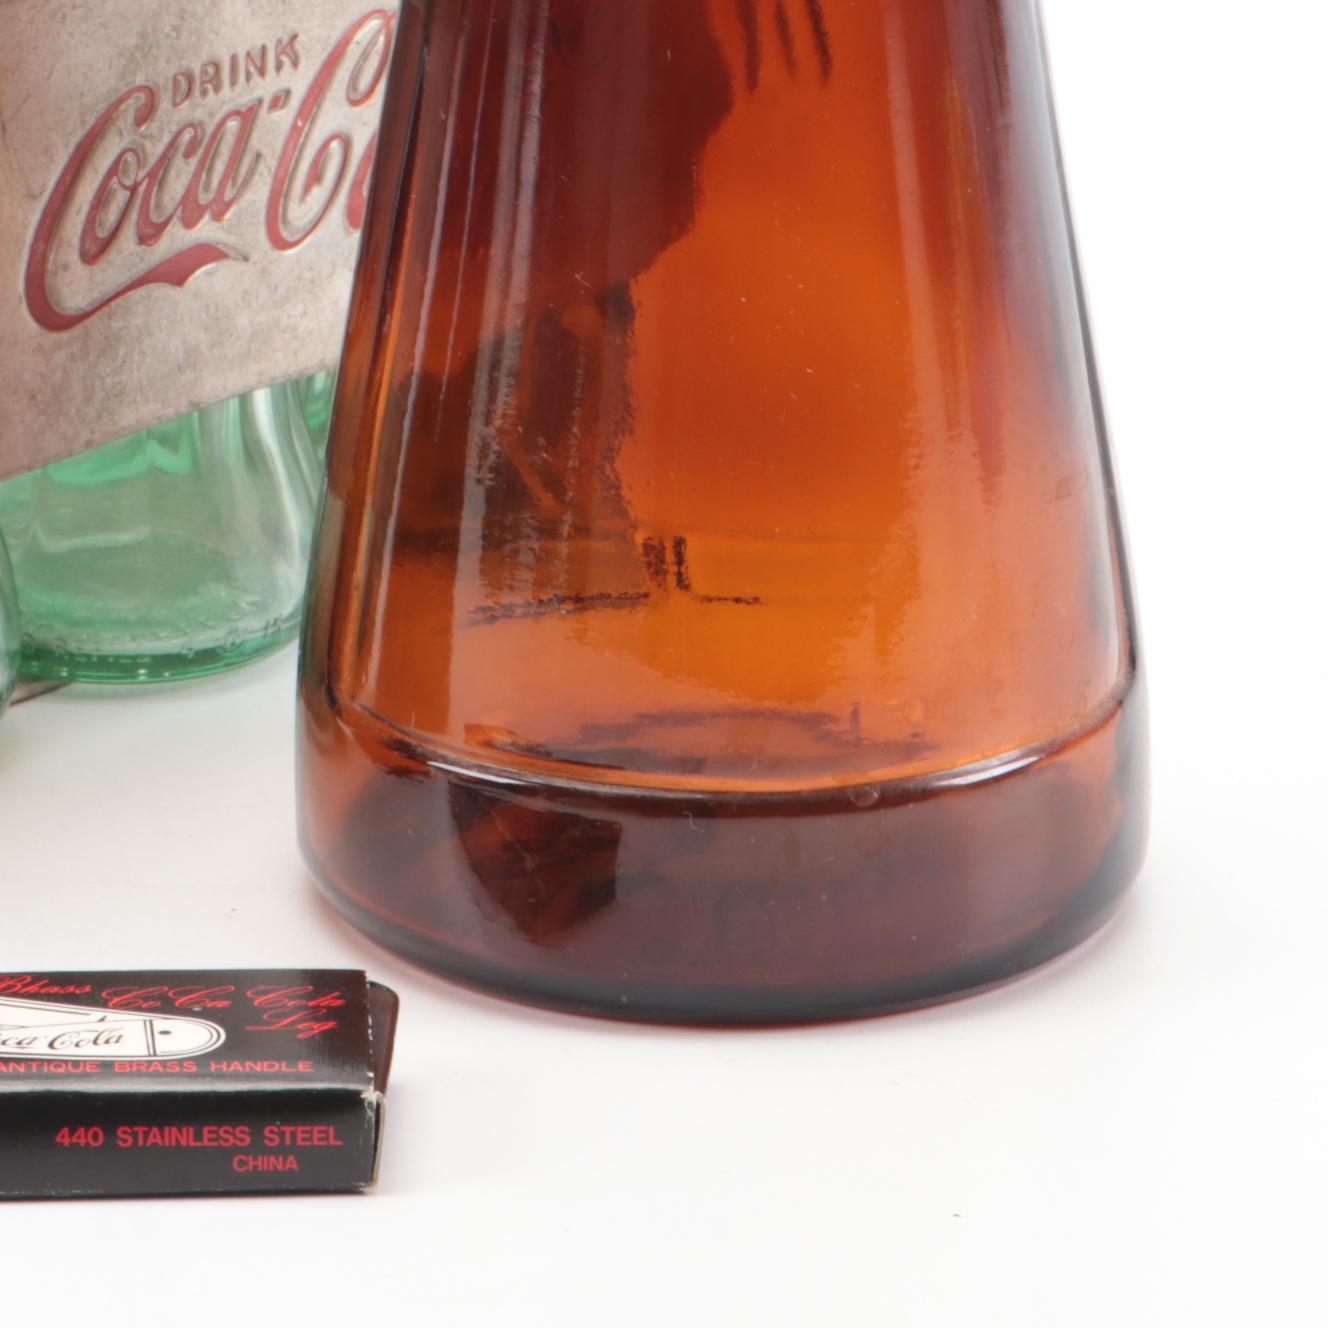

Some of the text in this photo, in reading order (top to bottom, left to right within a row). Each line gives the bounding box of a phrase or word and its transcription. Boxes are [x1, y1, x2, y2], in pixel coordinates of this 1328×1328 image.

[170, 32, 301, 108] DRINK
[113, 1060, 197, 1073] BRASS
[209, 1059, 314, 1073] HANDLE
[54, 1124, 344, 1148] 440 STAINLESS STEEL
[231, 1153, 300, 1172] CHINA
